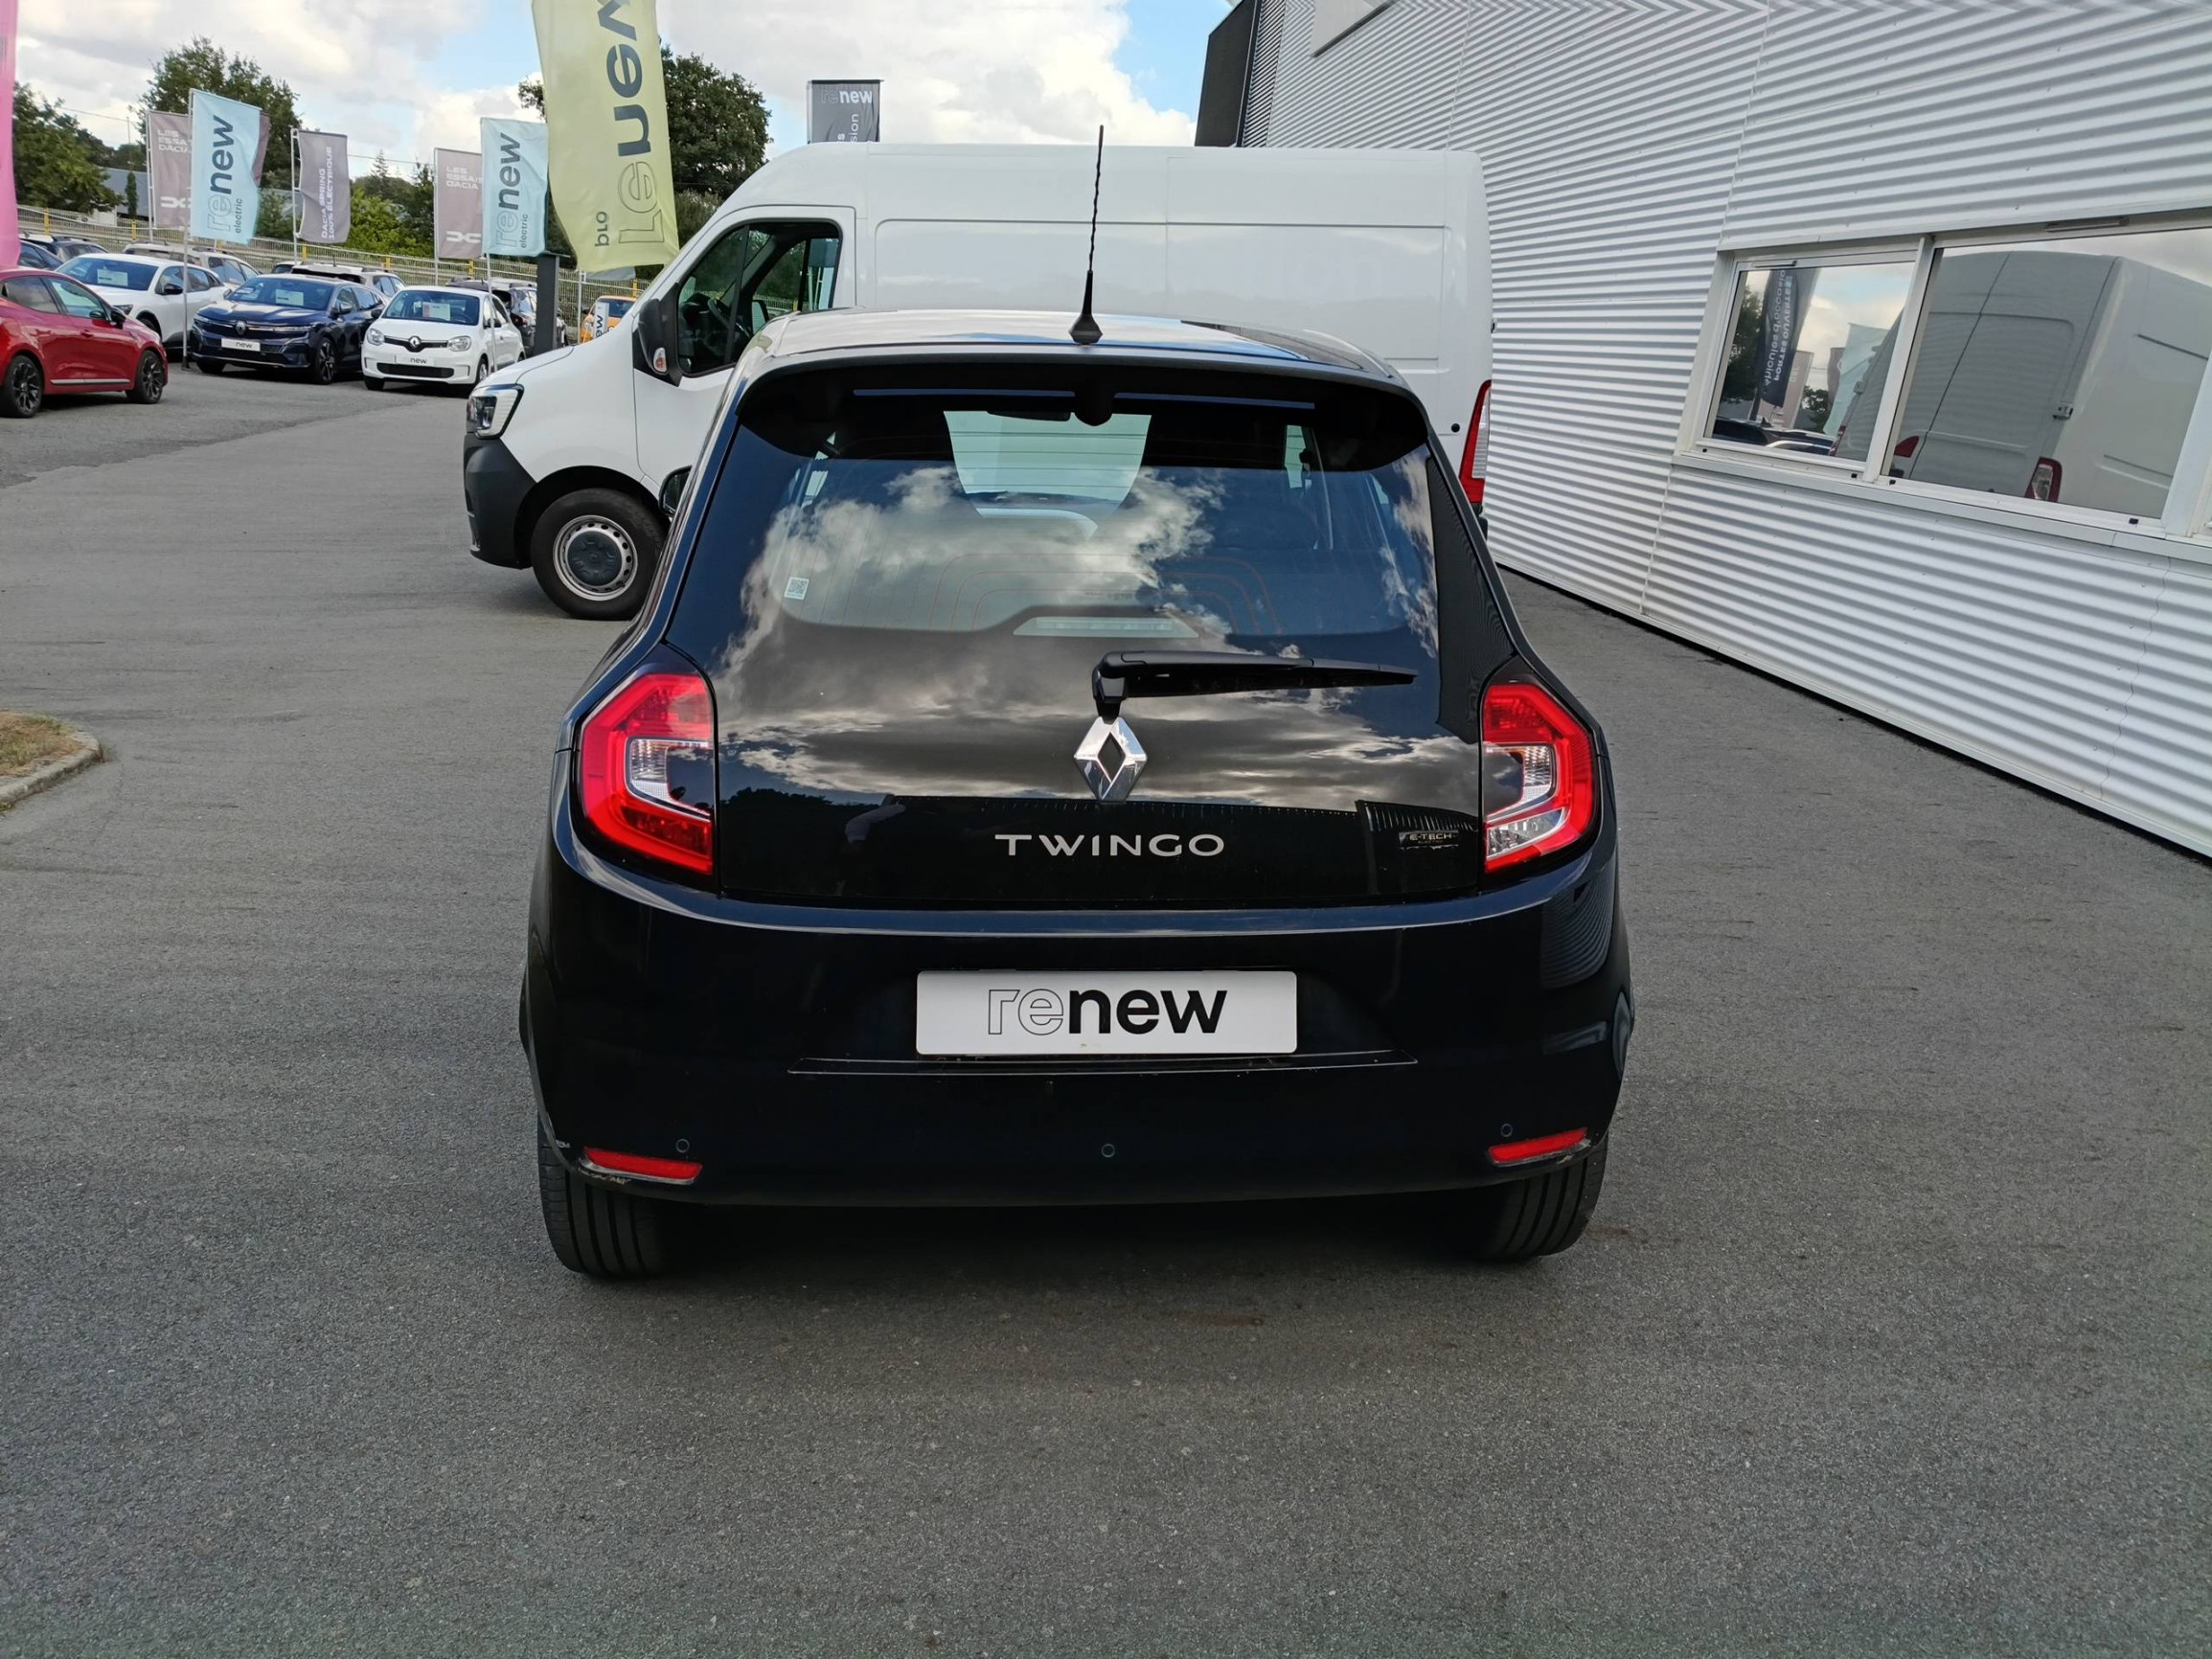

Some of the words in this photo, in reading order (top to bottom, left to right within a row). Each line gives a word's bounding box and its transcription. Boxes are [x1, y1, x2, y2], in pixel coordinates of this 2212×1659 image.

[821, 90, 873, 103] renew
[849, 113, 859, 143] sion
[207, 114, 235, 232] renew
[445, 180, 479, 191] DACIA
[446, 166, 467, 174] LES
[318, 168, 327, 207] SPRING
[495, 131, 520, 247] renew
[234, 197, 243, 234] electric
[518, 214, 529, 248] electric
[994, 833, 1225, 858] TWINGO
[988, 987, 1228, 1035] renew
